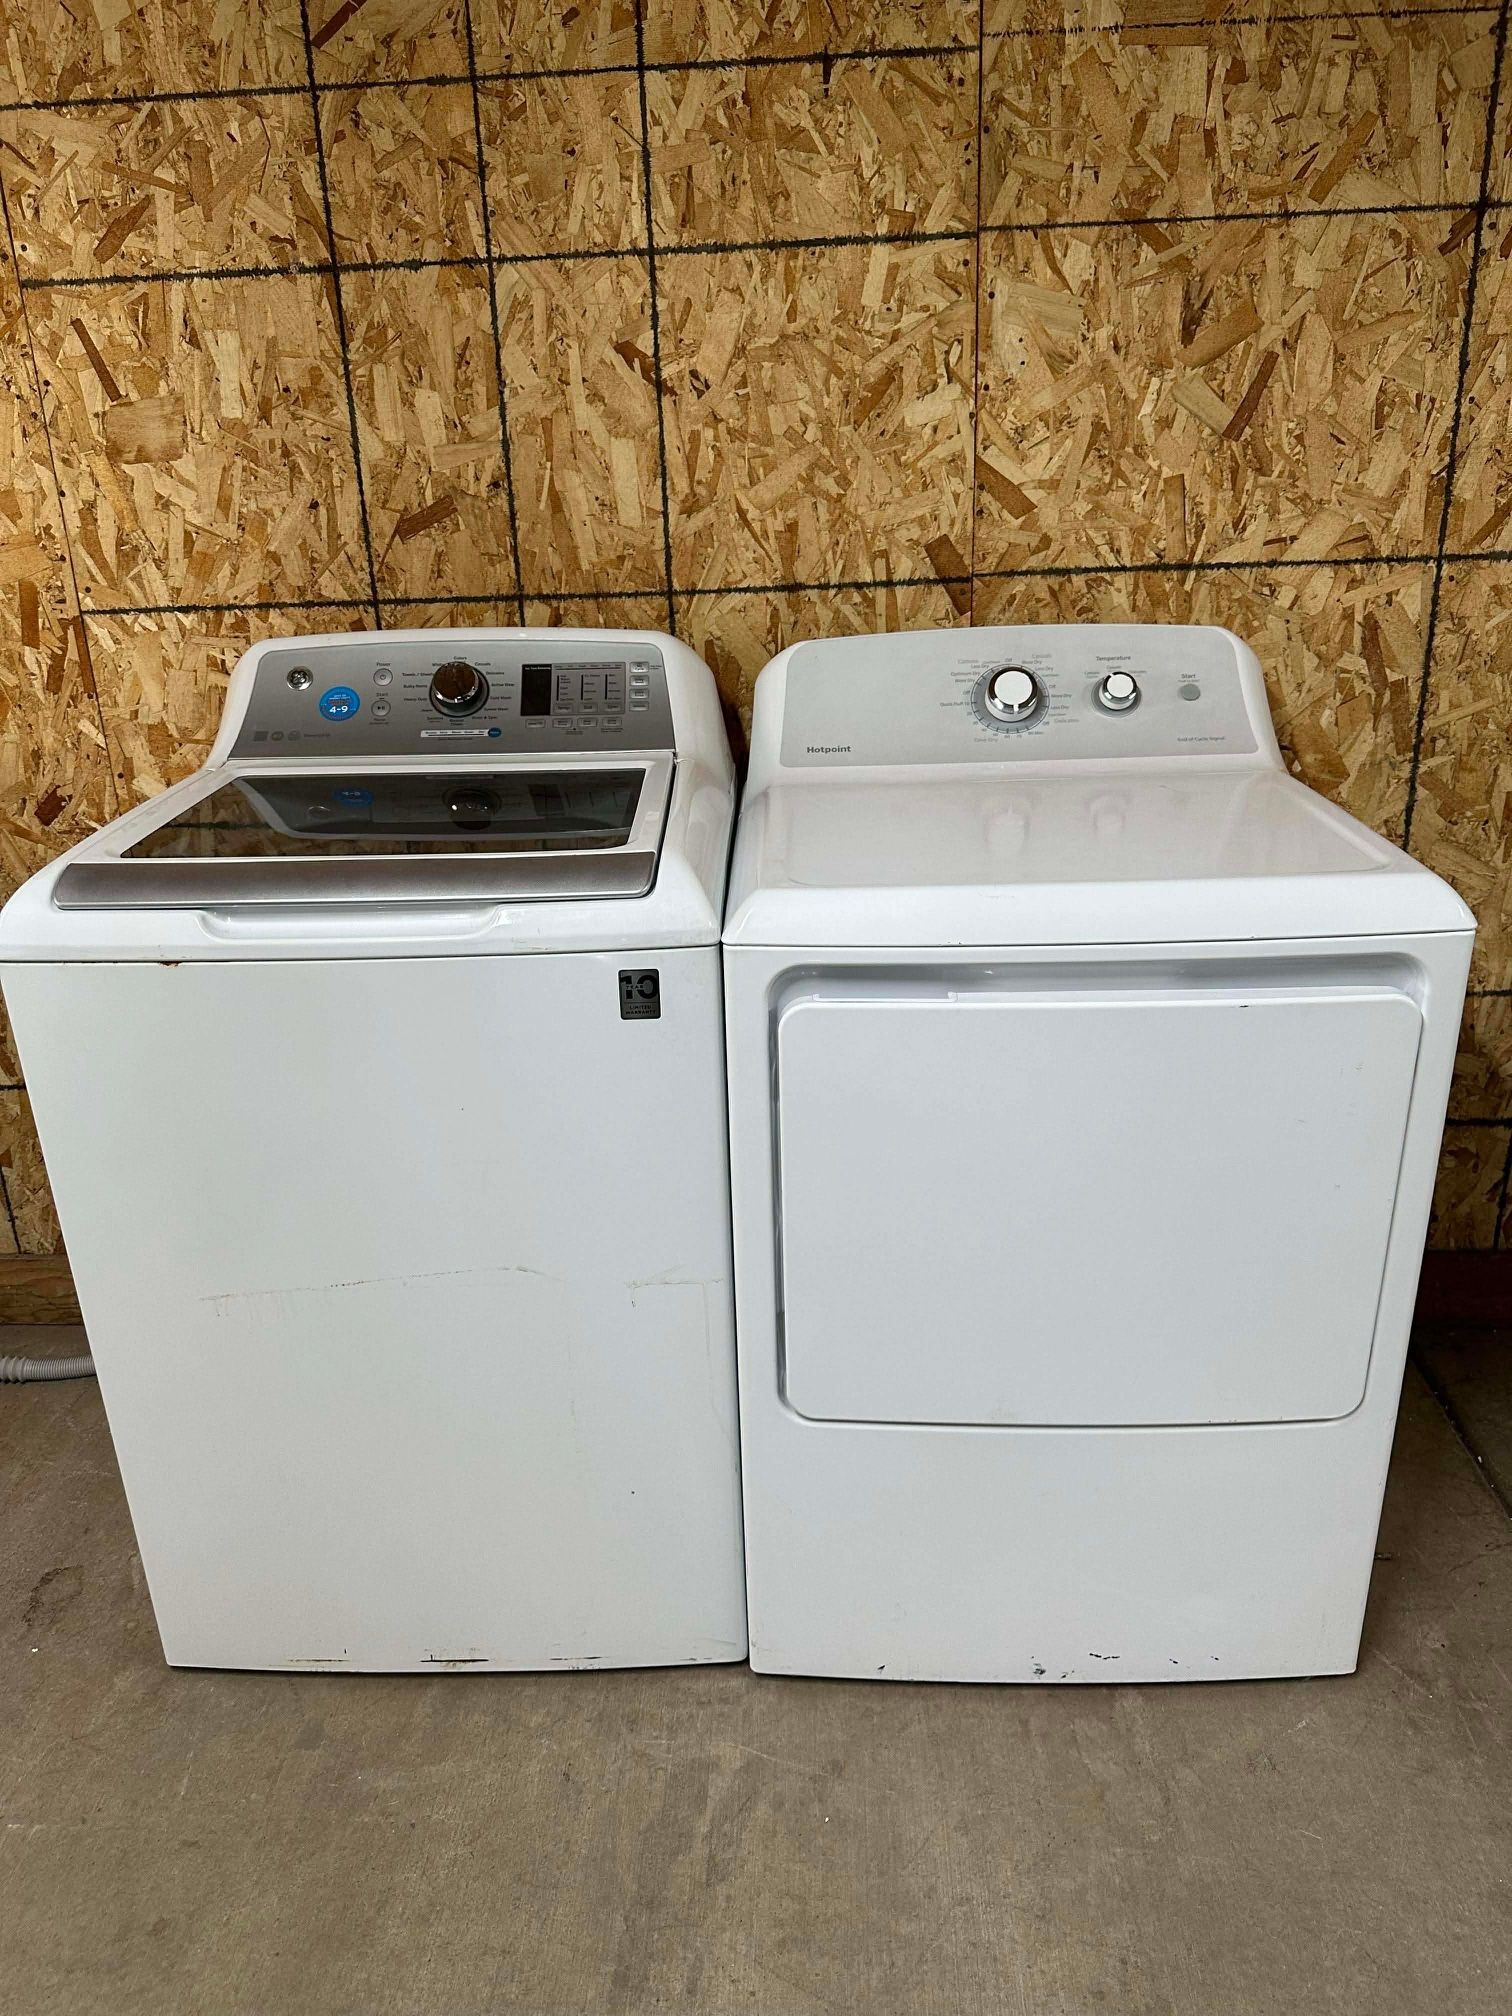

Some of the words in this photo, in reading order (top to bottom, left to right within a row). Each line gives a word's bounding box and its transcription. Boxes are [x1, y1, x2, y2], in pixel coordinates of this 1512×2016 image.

[329, 705, 349, 714] 4-9
[806, 745, 851, 754] Hotpoint
[620, 974, 658, 999] 10
